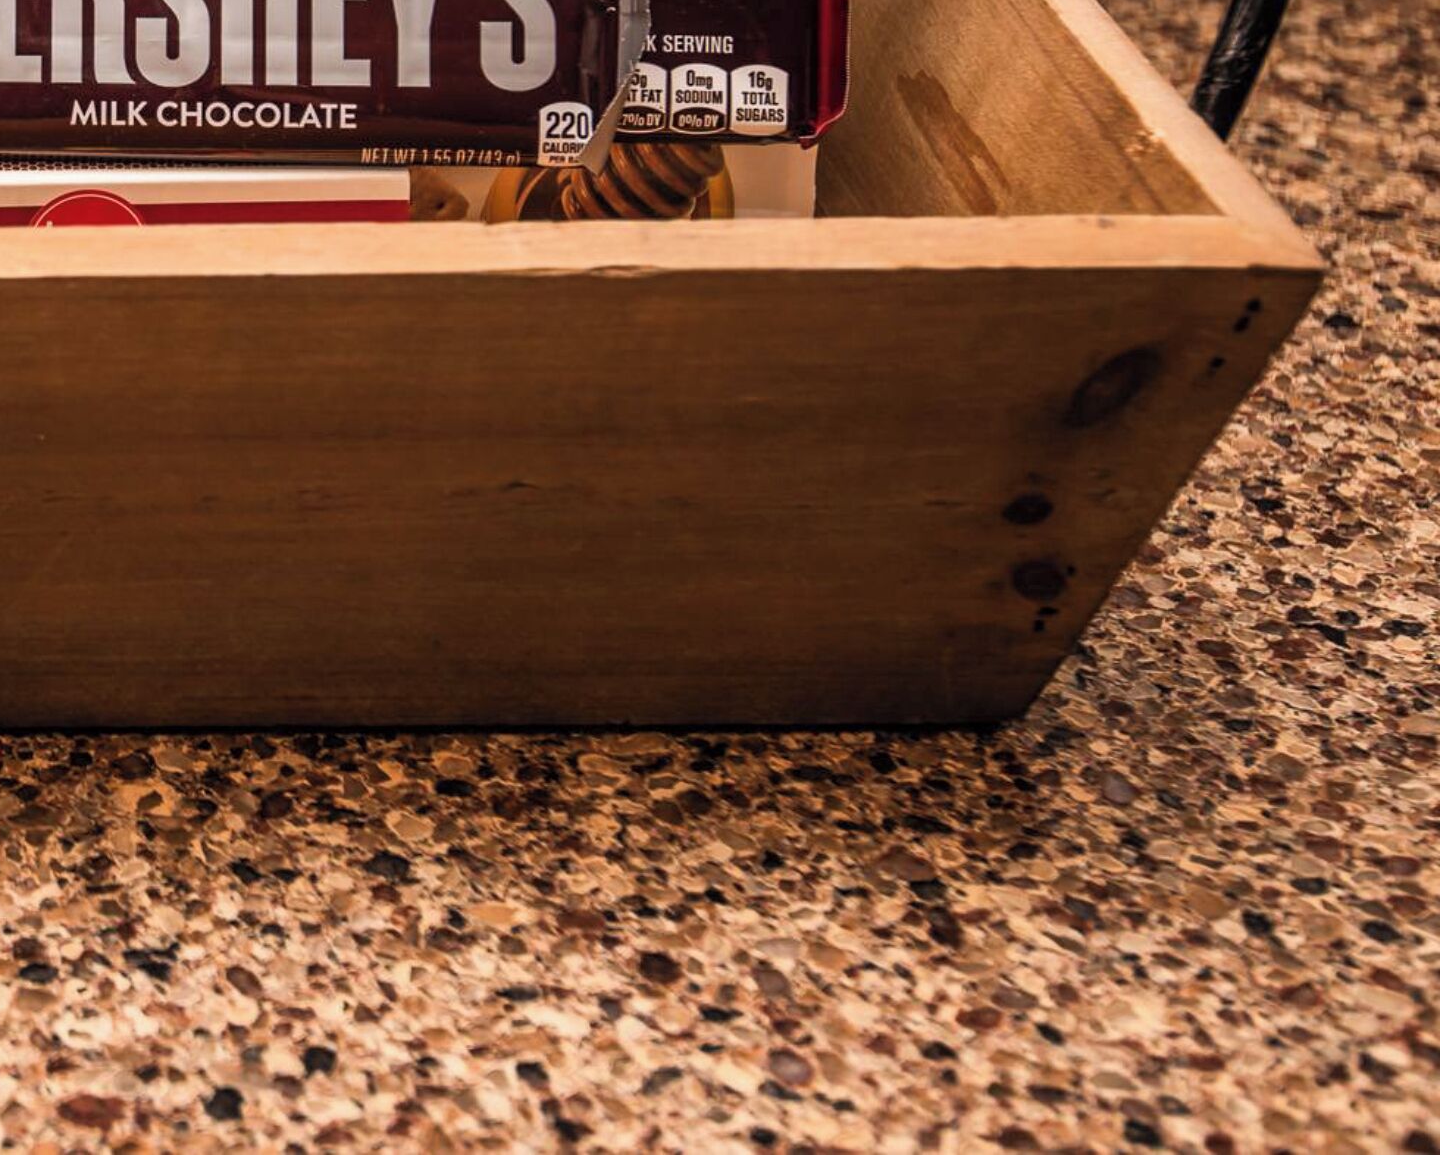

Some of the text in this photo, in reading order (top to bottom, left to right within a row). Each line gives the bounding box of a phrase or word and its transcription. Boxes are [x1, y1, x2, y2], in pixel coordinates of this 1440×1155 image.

[662, 35, 734, 54] SERVING
[685, 70, 713, 89] 0mg
[747, 71, 773, 91] 16g
[640, 89, 663, 103] FAT
[675, 90, 723, 104] SODIUM
[741, 91, 779, 106] TOTAL
[70, 100, 358, 129] MILK CHOCOLATE
[617, 113, 662, 126] 7% DV
[678, 114, 719, 127] 0% DV
[735, 108, 785, 122] SUGARS
[545, 111, 589, 140] 220
[361, 147, 390, 164] NET
[392, 147, 418, 164] WT
